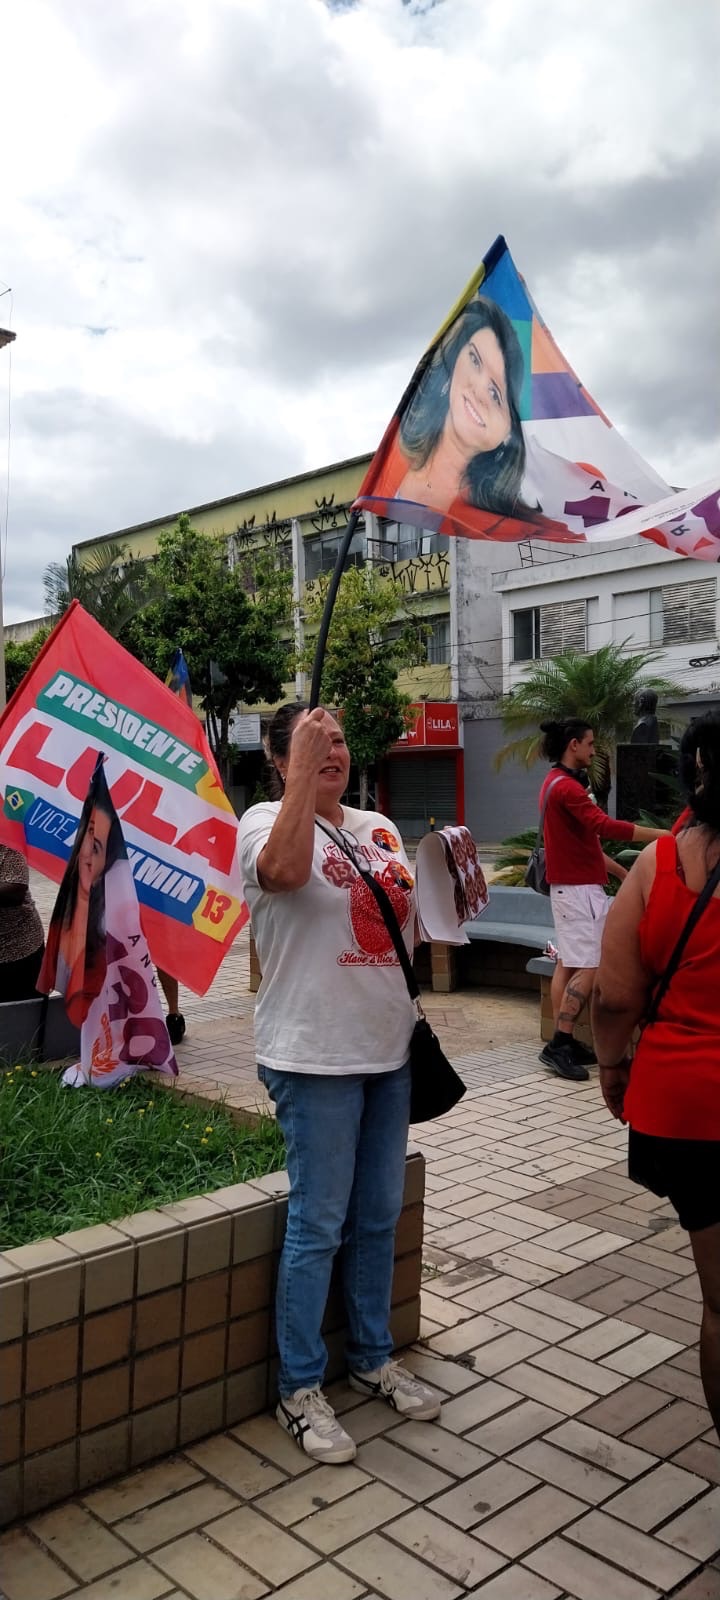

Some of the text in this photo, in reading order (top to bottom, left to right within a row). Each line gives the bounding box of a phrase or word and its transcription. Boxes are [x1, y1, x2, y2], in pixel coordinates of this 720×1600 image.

[44, 674, 204, 775] PRESIDENTE
[432, 719, 451, 729] LILA
[6, 720, 238, 876] LULA
[28, 801, 76, 841] VICE
[202, 889, 233, 925] 13
